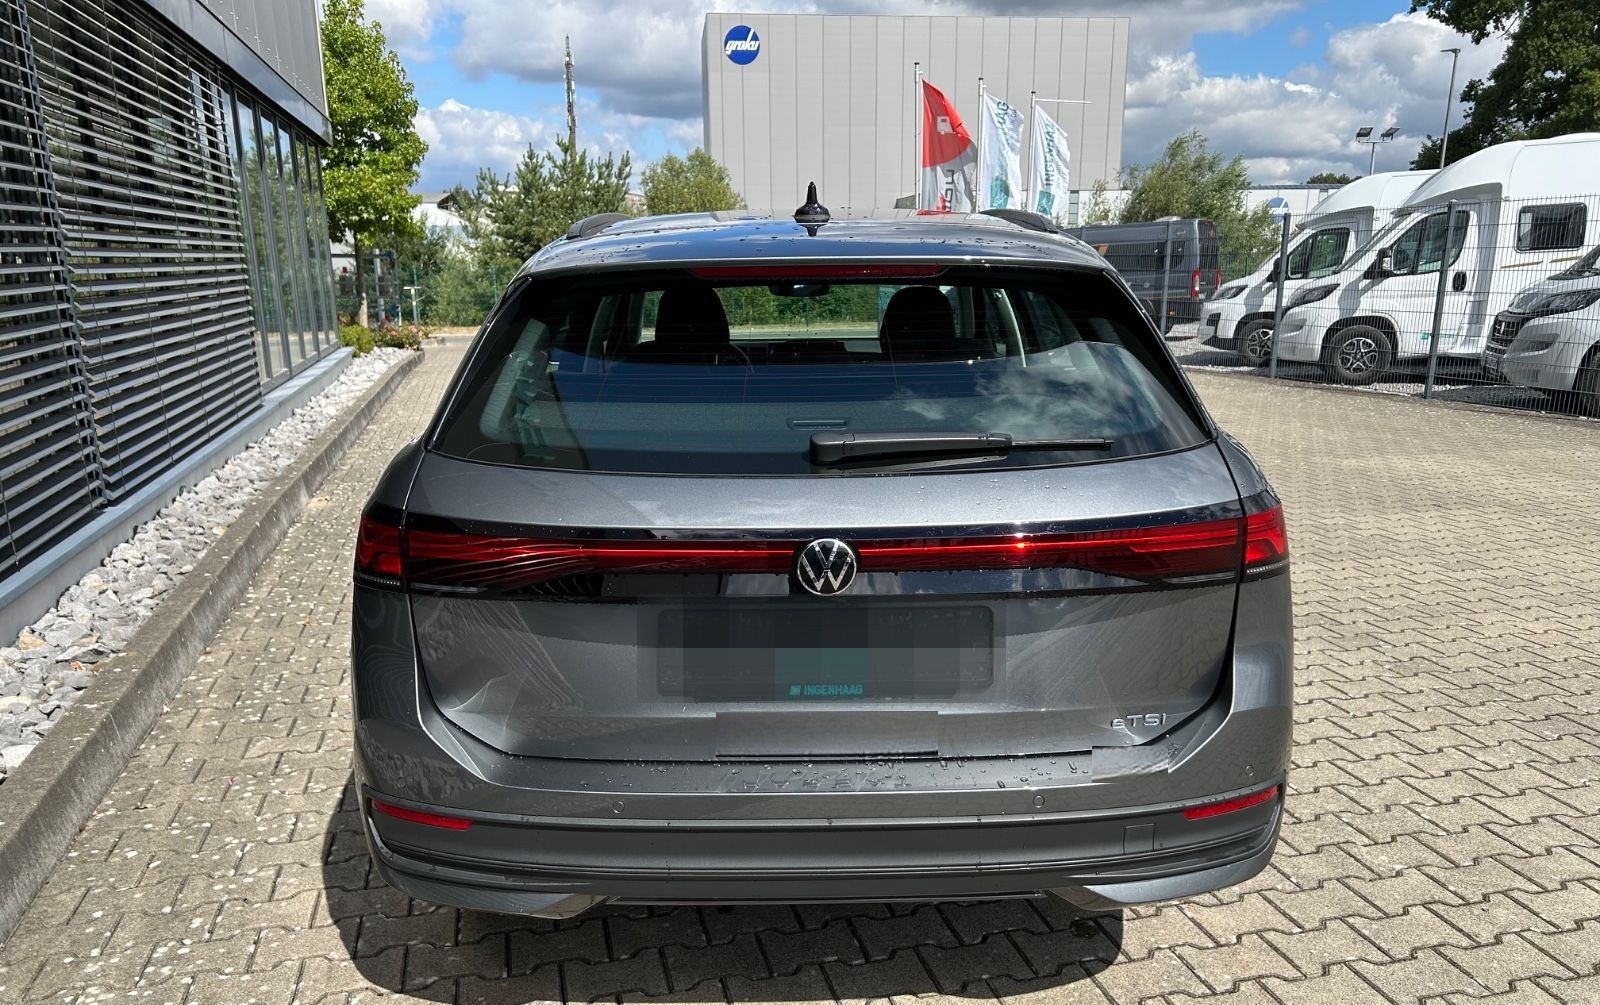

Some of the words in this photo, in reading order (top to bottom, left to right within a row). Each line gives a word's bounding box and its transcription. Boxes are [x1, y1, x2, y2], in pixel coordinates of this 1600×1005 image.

[725, 28, 760, 55] groku
[801, 539, 852, 592] VW
[803, 684, 863, 696] INGENHAAG
[1111, 712, 1167, 729] eTSI
